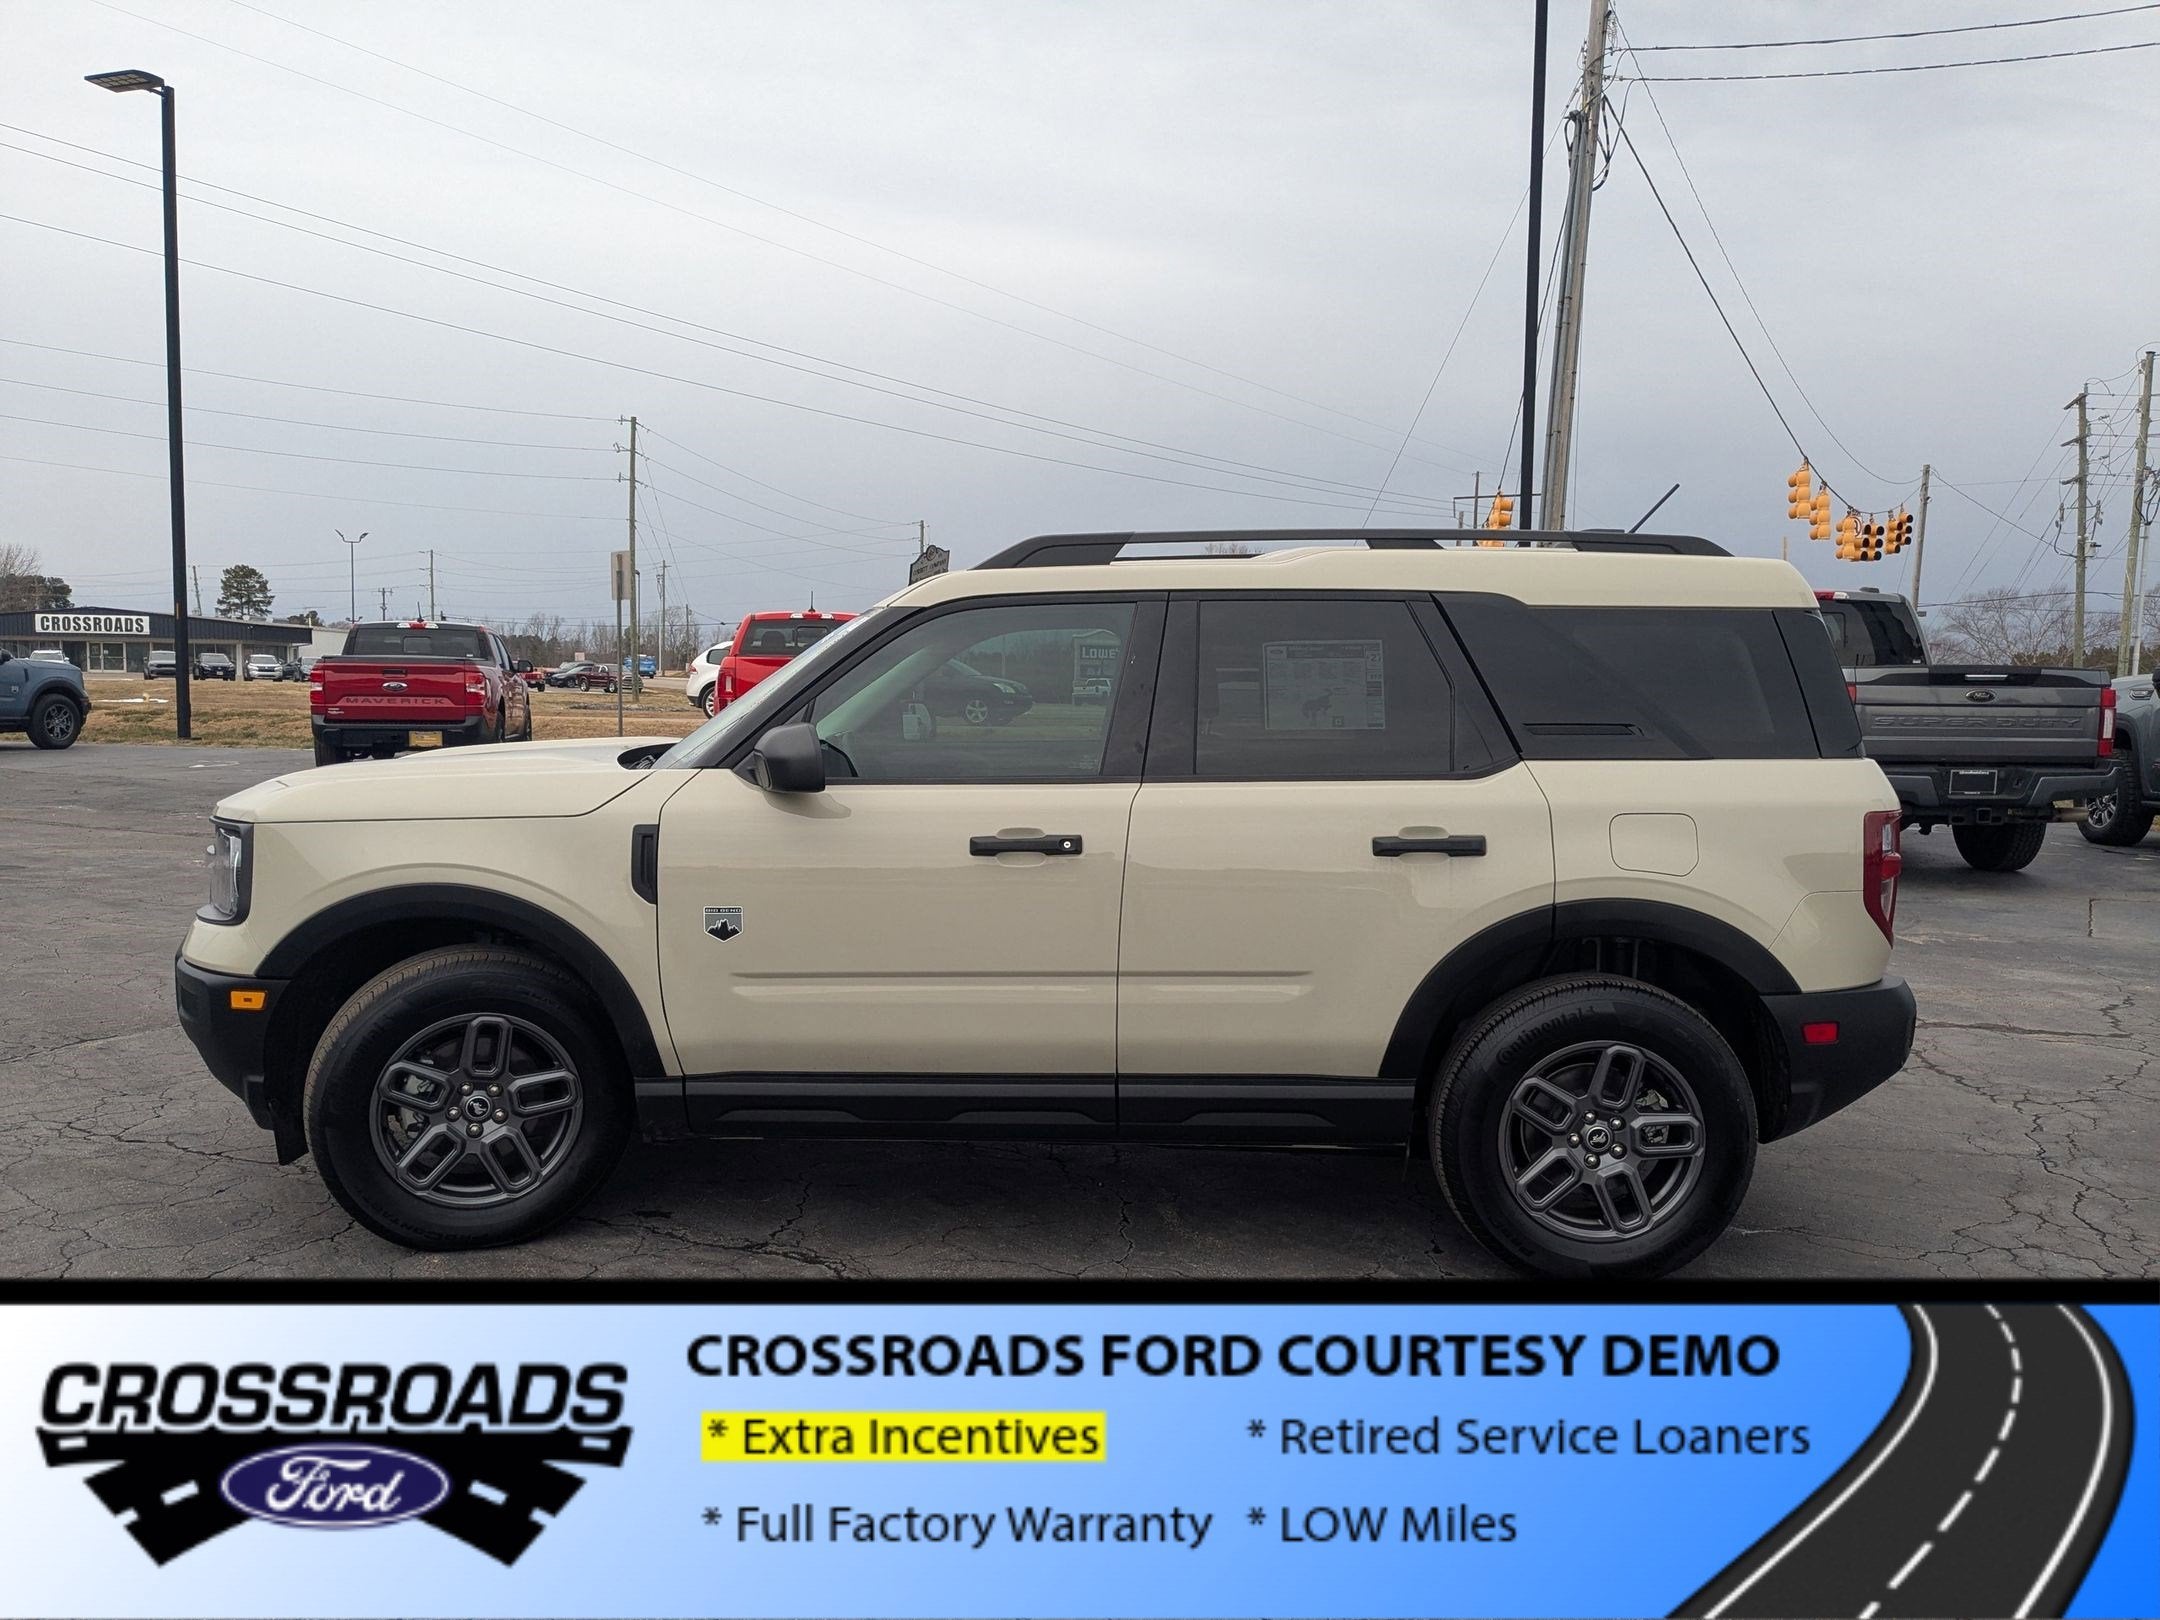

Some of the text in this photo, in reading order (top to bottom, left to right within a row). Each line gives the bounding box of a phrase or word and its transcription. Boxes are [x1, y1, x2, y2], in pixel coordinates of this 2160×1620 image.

[40, 615, 145, 633] CROSSROADS
[345, 697, 445, 705] MAVERICK
[1874, 716, 2081, 729] SUPER DUTY
[1496, 1006, 1584, 1065] Continental
